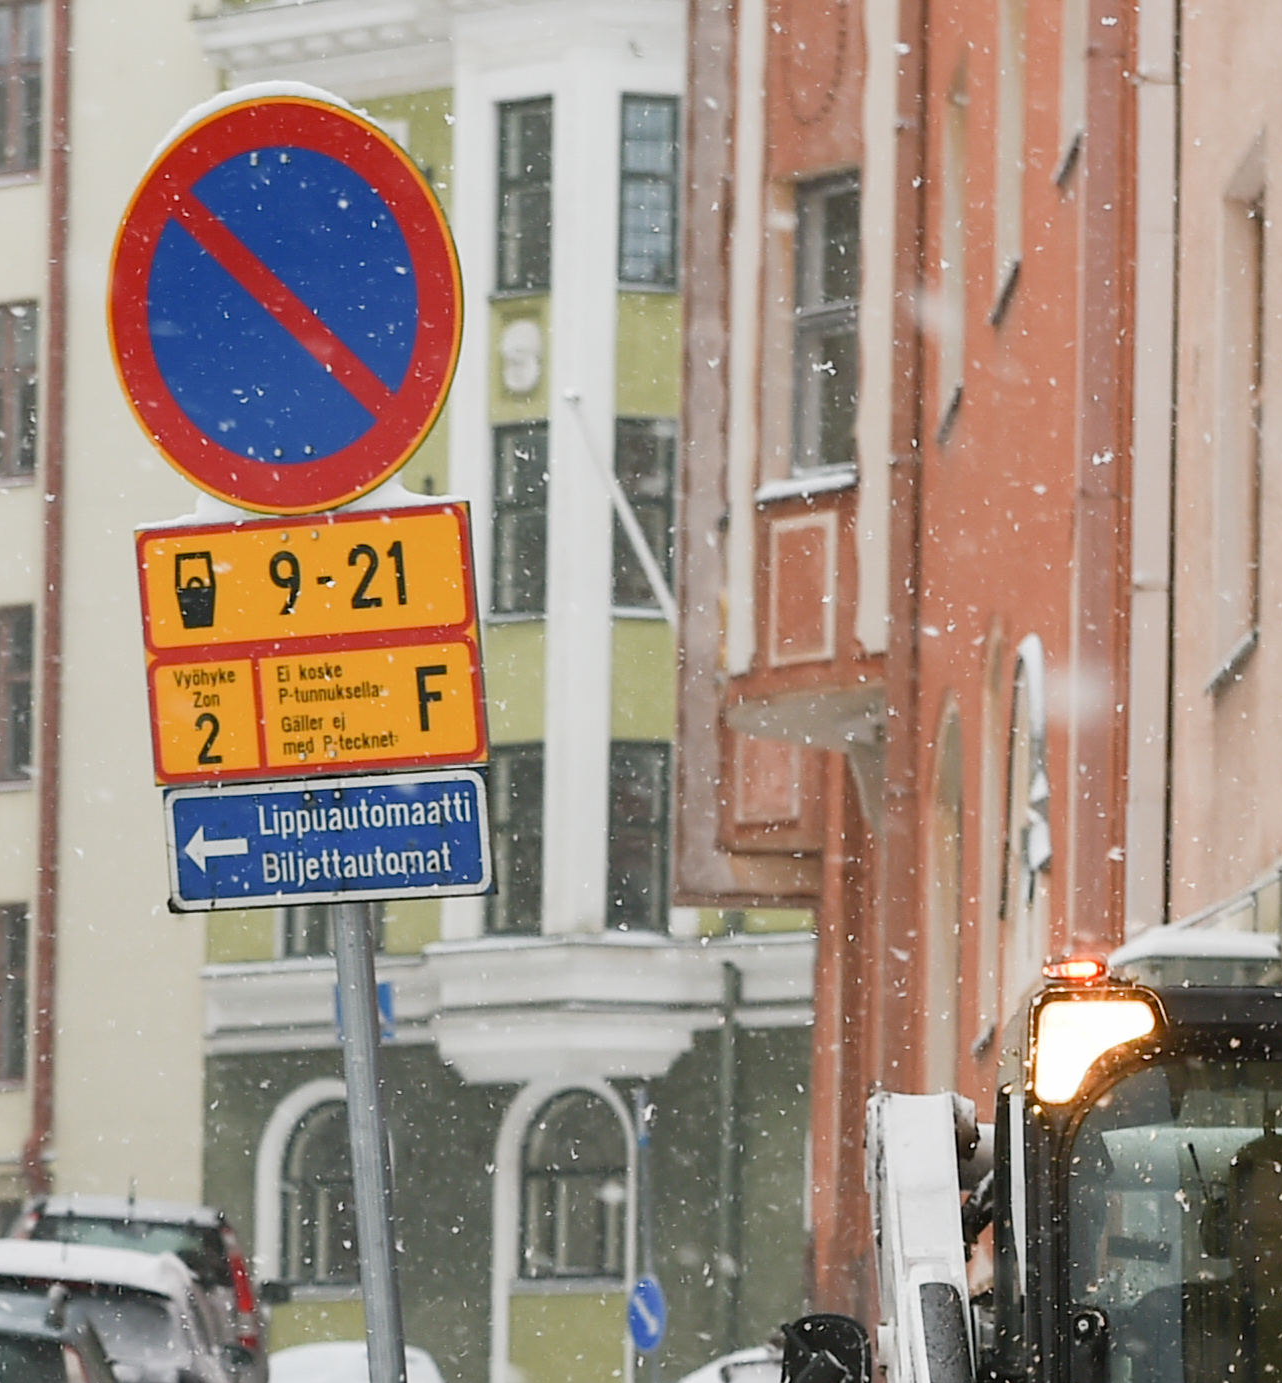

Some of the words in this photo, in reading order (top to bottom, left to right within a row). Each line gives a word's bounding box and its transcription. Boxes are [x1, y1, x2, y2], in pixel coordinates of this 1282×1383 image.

[172, 668, 236, 690] Vyöhyke
[276, 665, 291, 682] Ei
[299, 662, 343, 681] koske
[192, 691, 221, 709] Zon
[415, 665, 448, 732] F
[281, 714, 324, 733] Gäller
[333, 712, 346, 732] ej
[194, 712, 223, 765] 2
[283, 737, 315, 755] med
[258, 792, 471, 840] Lippuautomaatti
[261, 841, 452, 888] Biljettautomat
